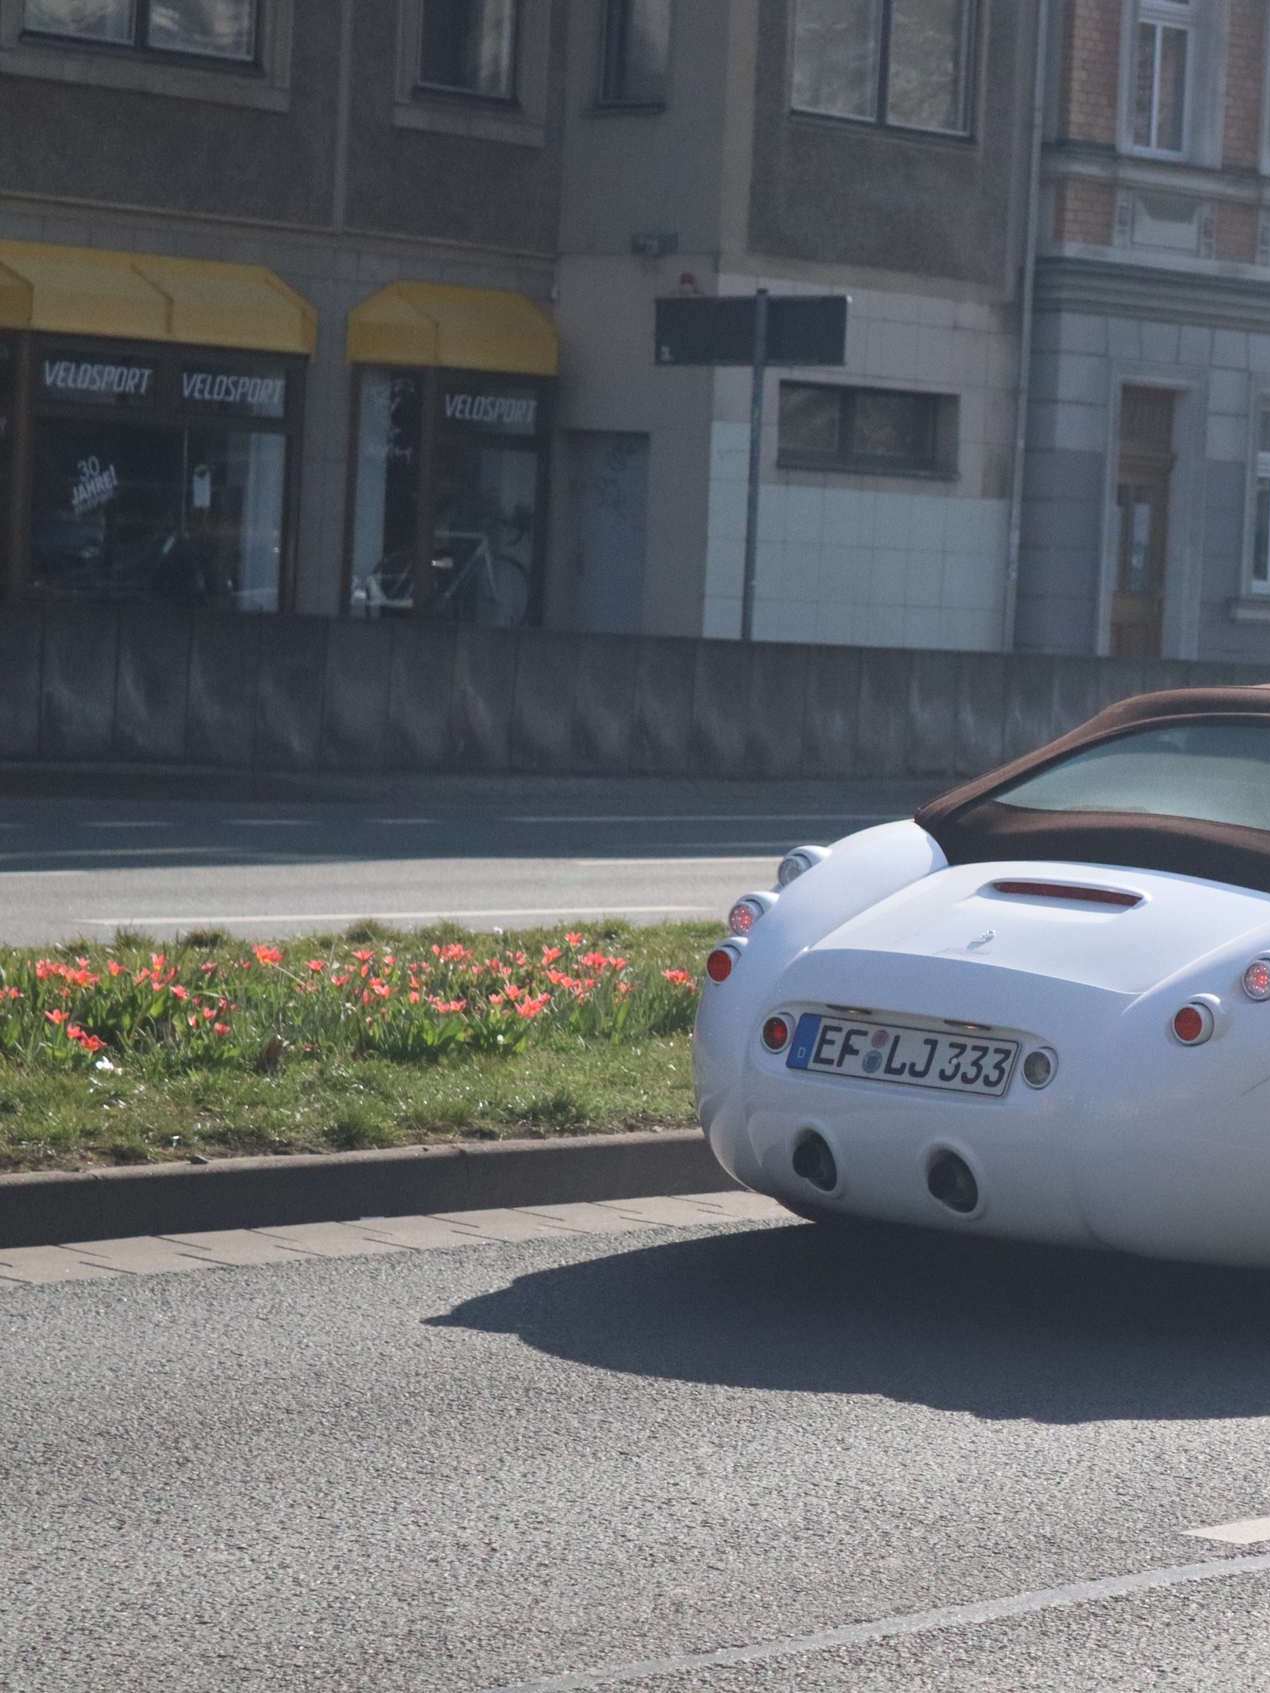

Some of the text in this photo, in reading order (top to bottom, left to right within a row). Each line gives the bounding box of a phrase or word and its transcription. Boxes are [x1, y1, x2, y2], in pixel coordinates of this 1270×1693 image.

[43, 360, 153, 394] VELOSPORT
[183, 371, 285, 405] VELOSPORT
[445, 393, 537, 423] VELOSPORT
[72, 464, 118, 505] JAHRE!
[77, 455, 100, 482] 30
[797, 1025, 1012, 1087] D EF LJ 333
